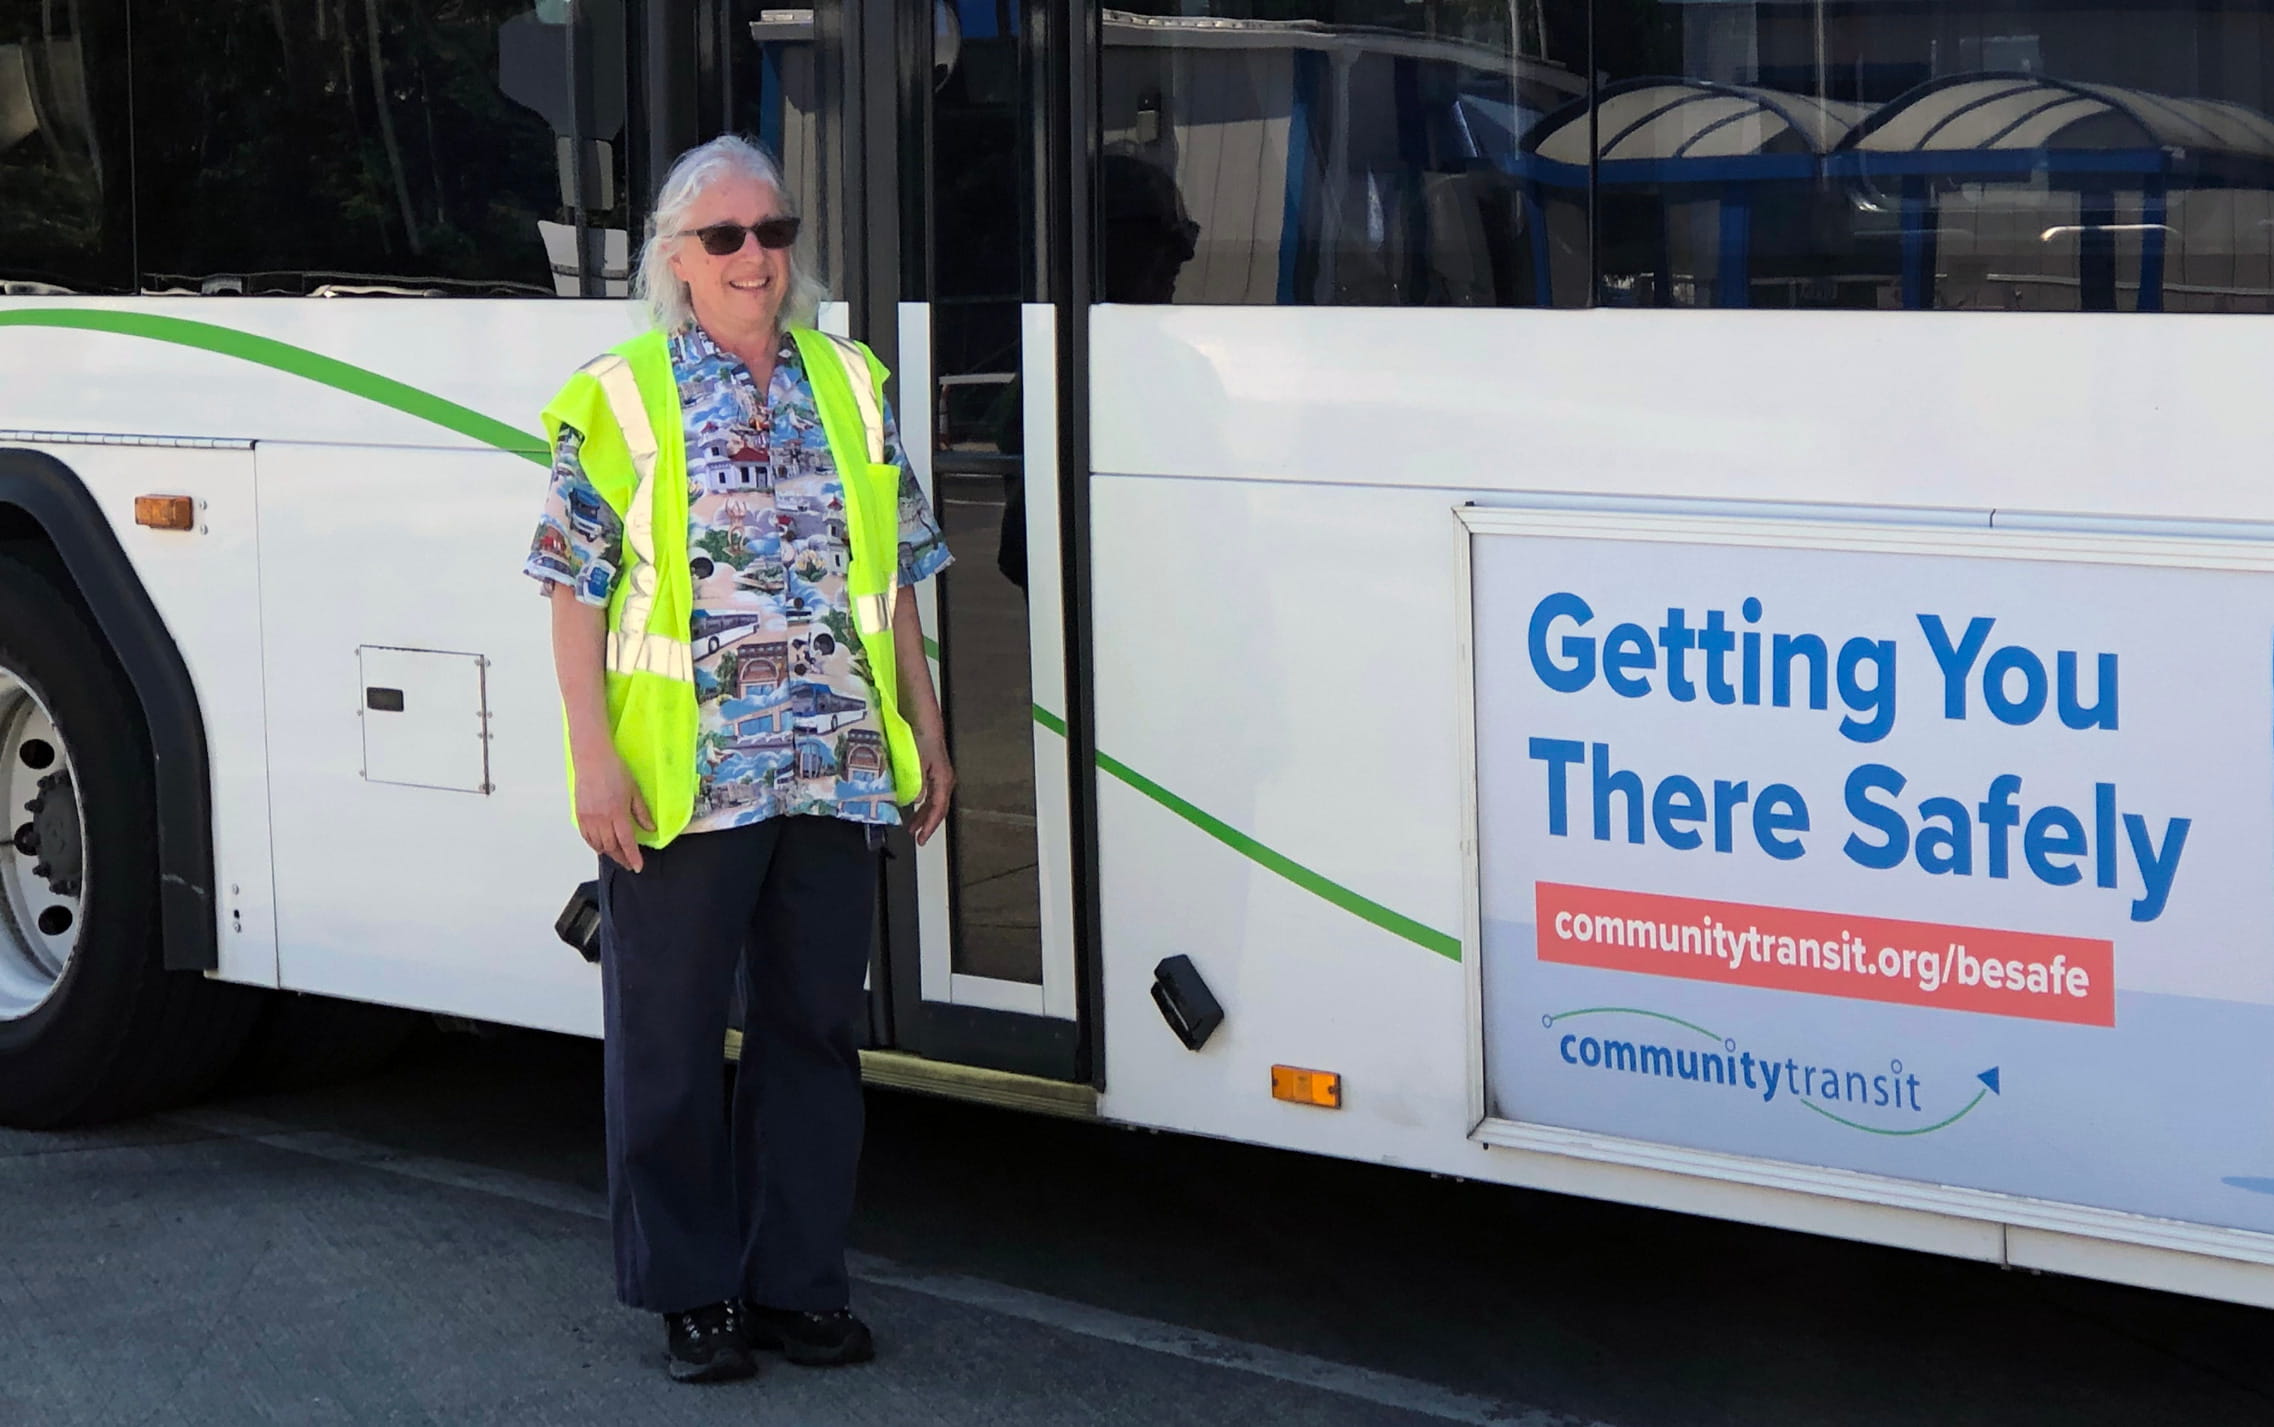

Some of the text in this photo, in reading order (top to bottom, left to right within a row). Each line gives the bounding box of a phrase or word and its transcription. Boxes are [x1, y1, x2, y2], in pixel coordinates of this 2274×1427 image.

[1528, 593, 2119, 743] Getting You
[1529, 737, 2191, 922] There Safely
[1555, 909, 2090, 998] communitytransit.org/besafe
